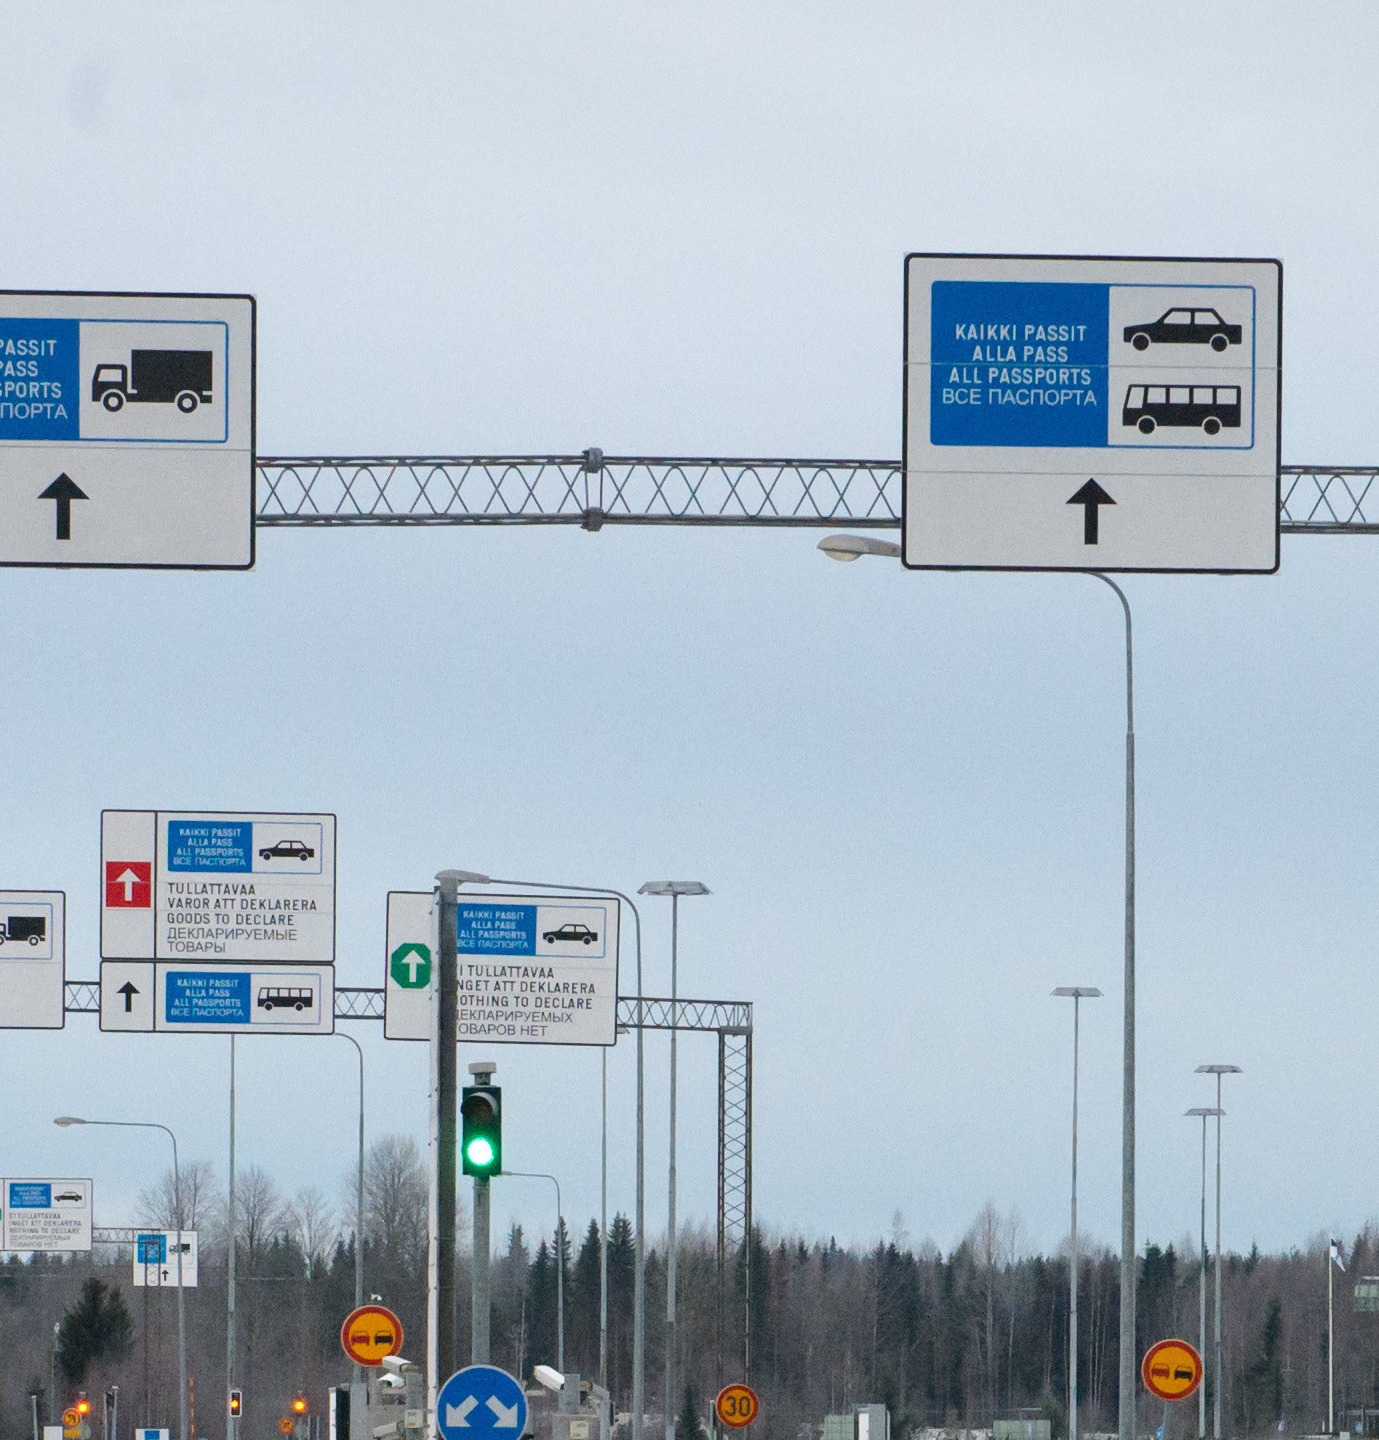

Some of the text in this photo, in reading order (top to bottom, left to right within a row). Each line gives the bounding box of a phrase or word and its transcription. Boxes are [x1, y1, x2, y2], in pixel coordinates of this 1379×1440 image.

[955, 323, 1087, 342] KAIKKI PASSIT
[971, 345, 1068, 363] ALLA PASS
[949, 366, 1092, 385] ALL PASSPORTS
[942, 388, 1097, 407] ВСЕ ПАСПОРТА
[179, 828, 242, 837] KAIKKI PASSIT
[187, 837, 233, 847] ALLA PASS
[176, 847, 244, 857] ALL PASSPORTS
[168, 882, 256, 895] TULLATTAVAA
[167, 897, 317, 911] VAROR ATT DEKLARERA
[167, 913, 295, 926] GOODS TO DECLARE
[463, 910, 525, 920] KAIKKI PASSIT
[471, 920, 516, 929] ALLA PASS
[167, 927, 297, 941] ДЕКЛАРИРУЕМЫЕ
[460, 929, 526, 940] ALL PASSPORTS
[167, 941, 226, 953] ТОВАРЫ
[468, 965, 554, 979] TULLATTAVAA
[177, 978, 239, 988] KAIKKI PASSIT
[457, 980, 596, 994] NGET ATT DEKLARERA
[185, 988, 230, 997] ALLA PASS
[173, 998, 241, 1007] ALL PASSPORTS
[460, 995, 593, 1010] OTHING TO DECLARE
[458, 1023, 548, 1037] ОВАРОВ НЕТ
[725, 1396, 751, 1417] 30
